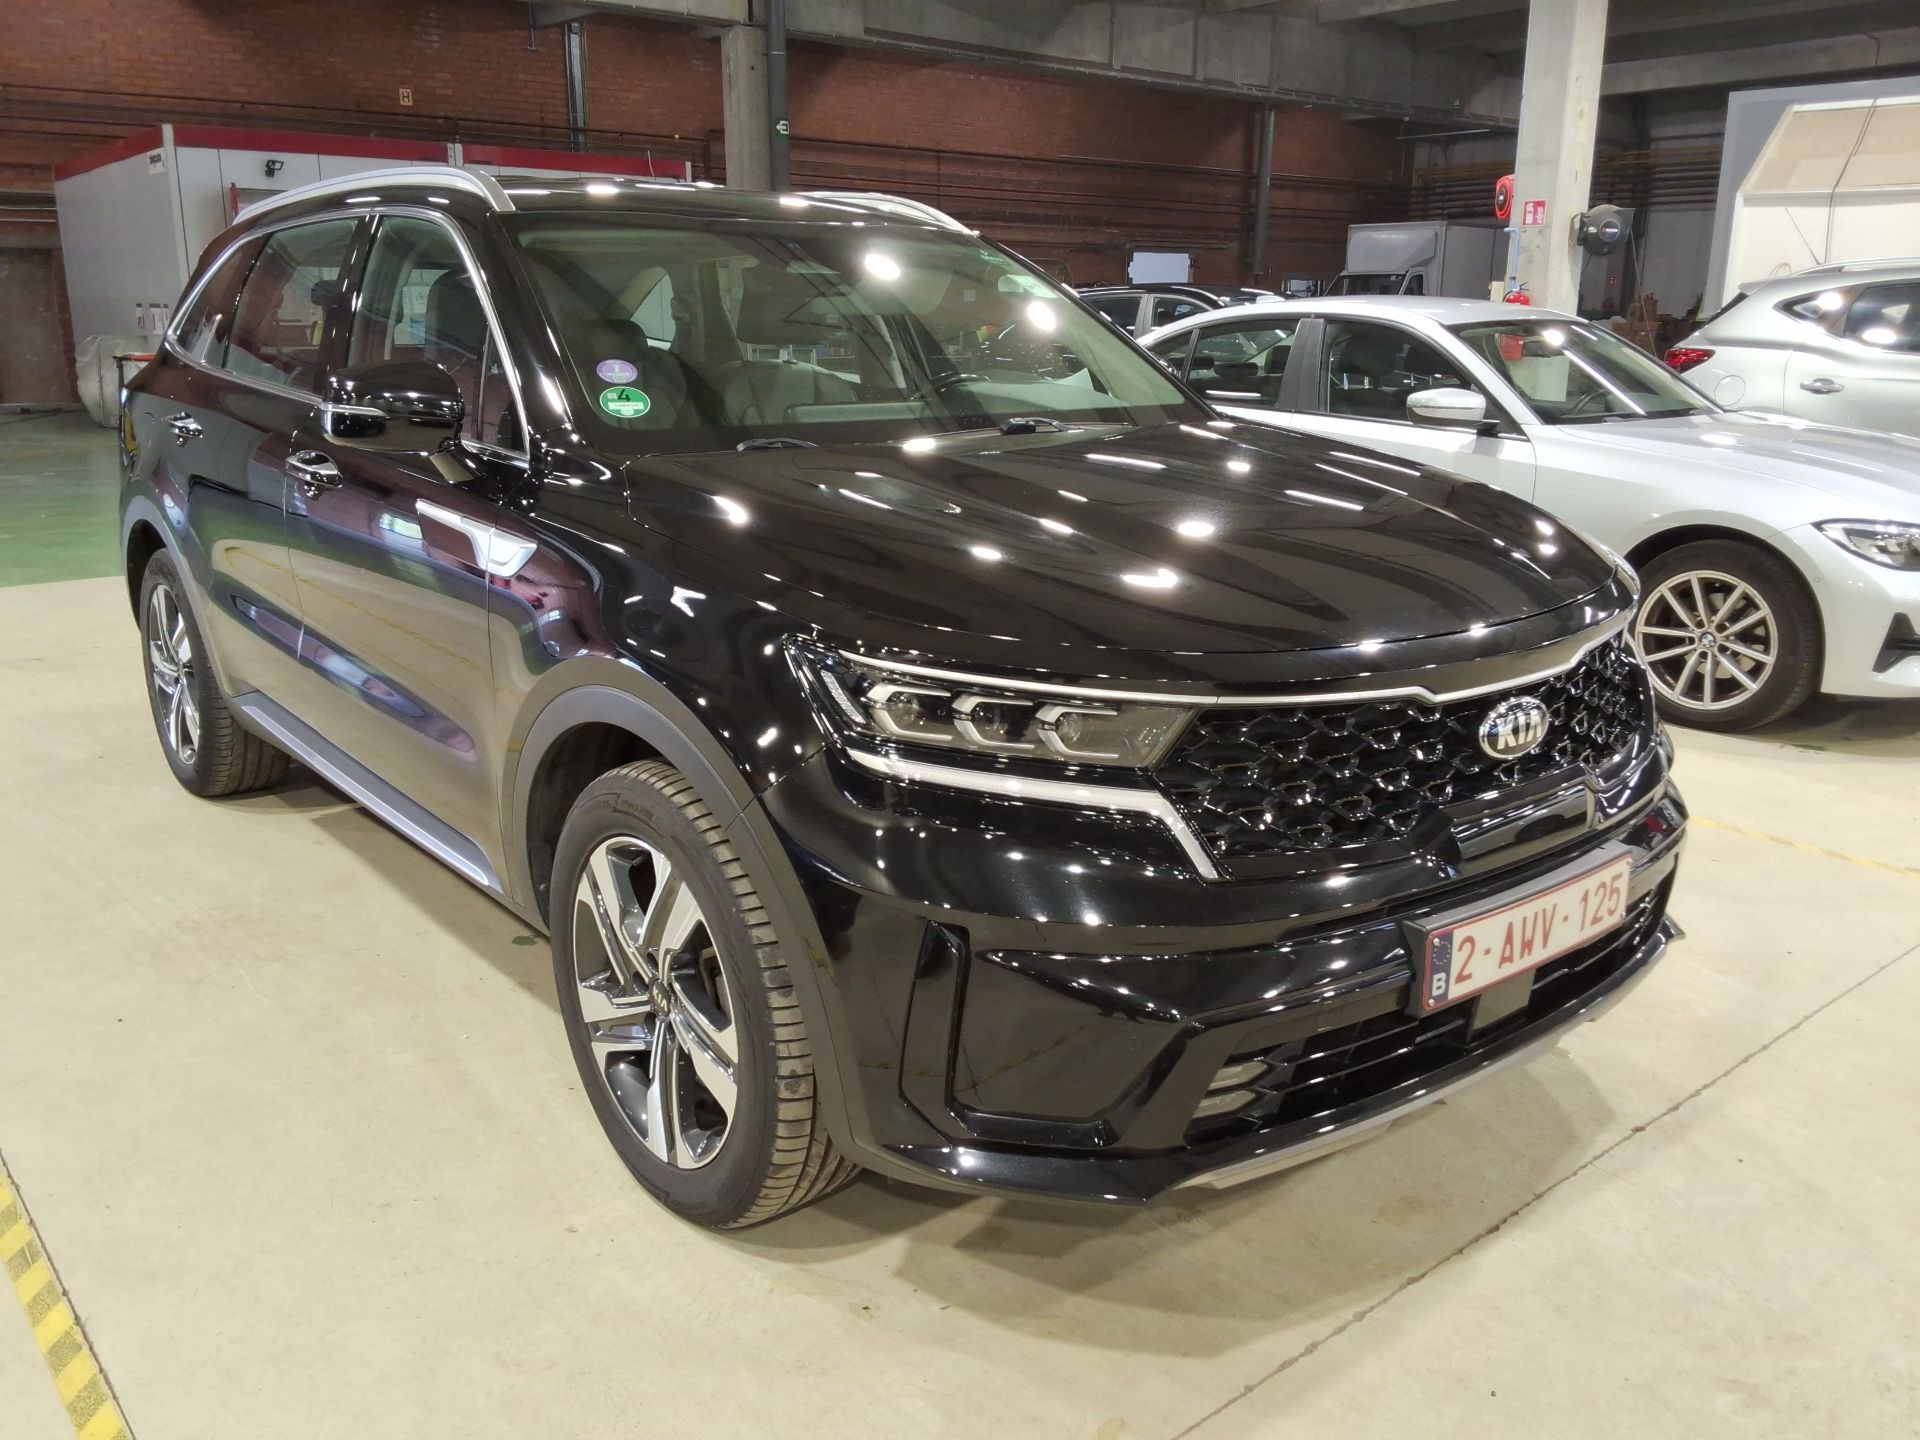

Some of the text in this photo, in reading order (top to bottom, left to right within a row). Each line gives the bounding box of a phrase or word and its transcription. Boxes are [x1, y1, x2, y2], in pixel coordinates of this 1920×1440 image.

[402, 91, 410, 103] H
[617, 388, 631, 402] 4
[1495, 709, 1543, 750] KIA
[1432, 972, 1447, 997] B
